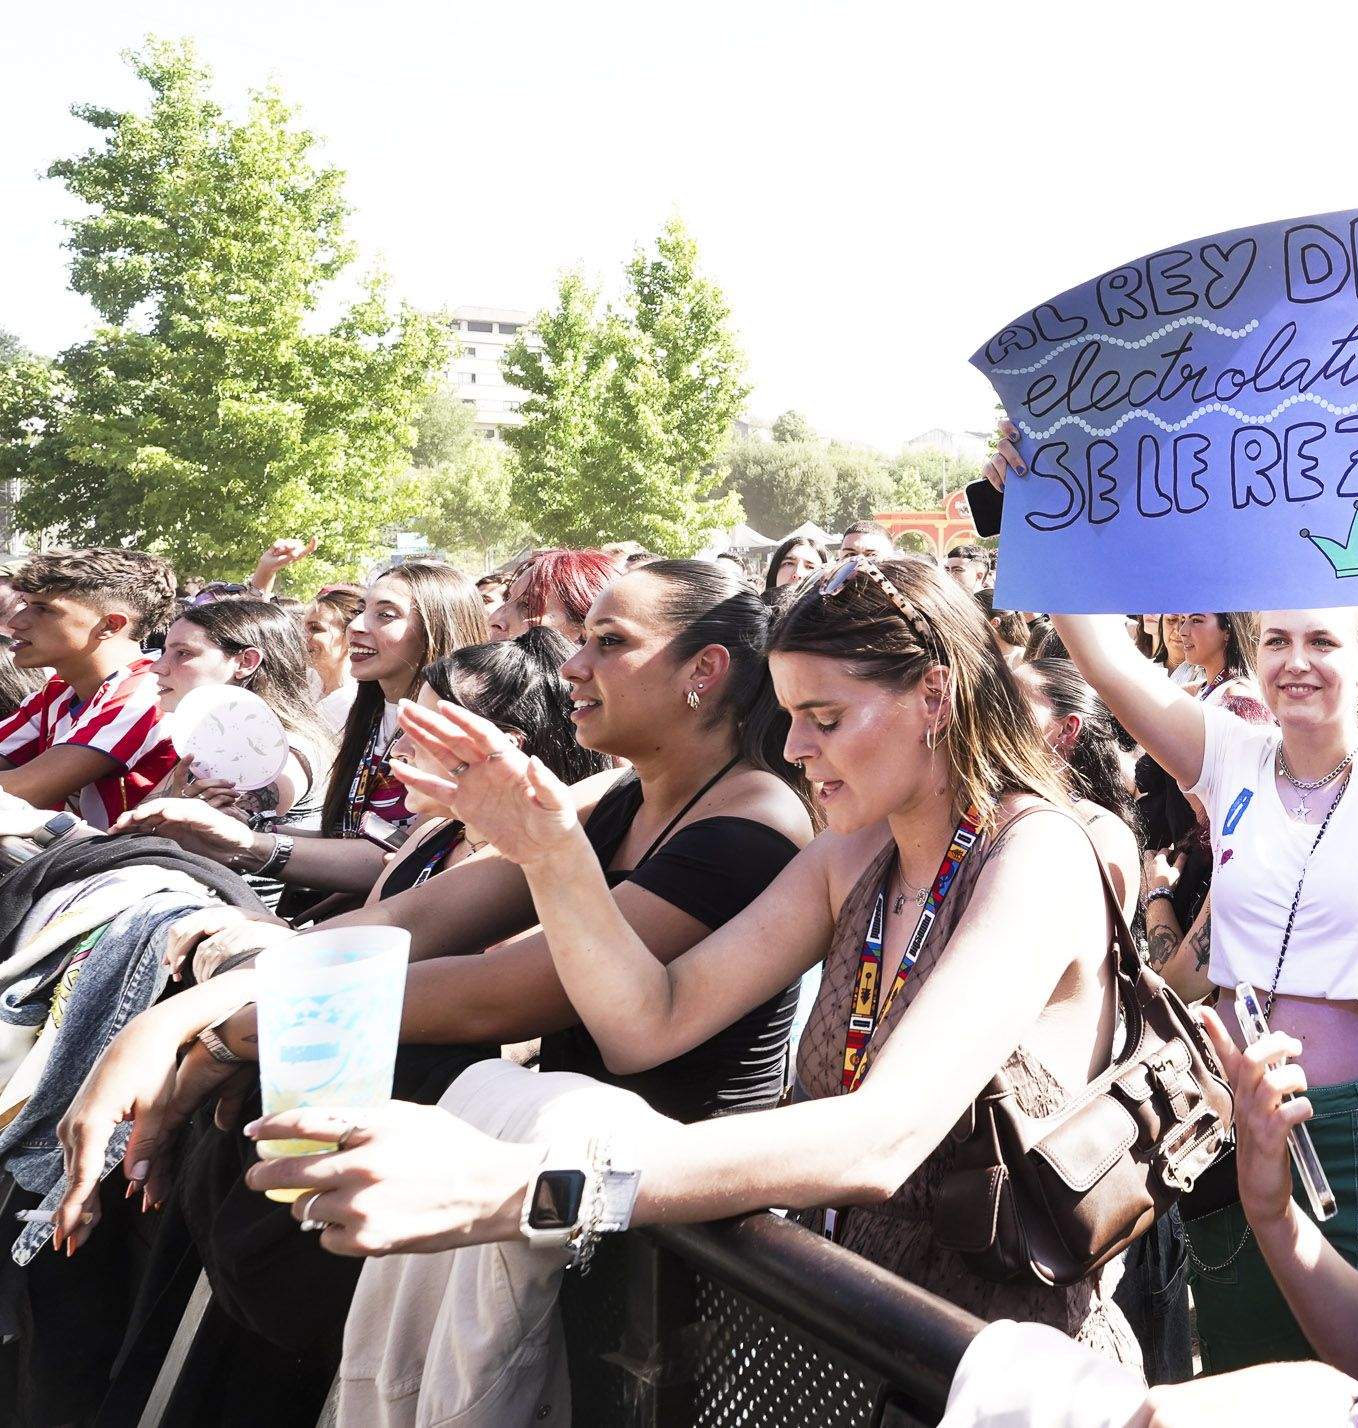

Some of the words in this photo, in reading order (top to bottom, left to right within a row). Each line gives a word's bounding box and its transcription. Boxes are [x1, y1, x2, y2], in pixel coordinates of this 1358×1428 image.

[984, 304, 1089, 366] AL
[1096, 237, 1258, 327] REY
[1024, 438, 1122, 532] SE
[1136, 433, 1212, 519] LE
